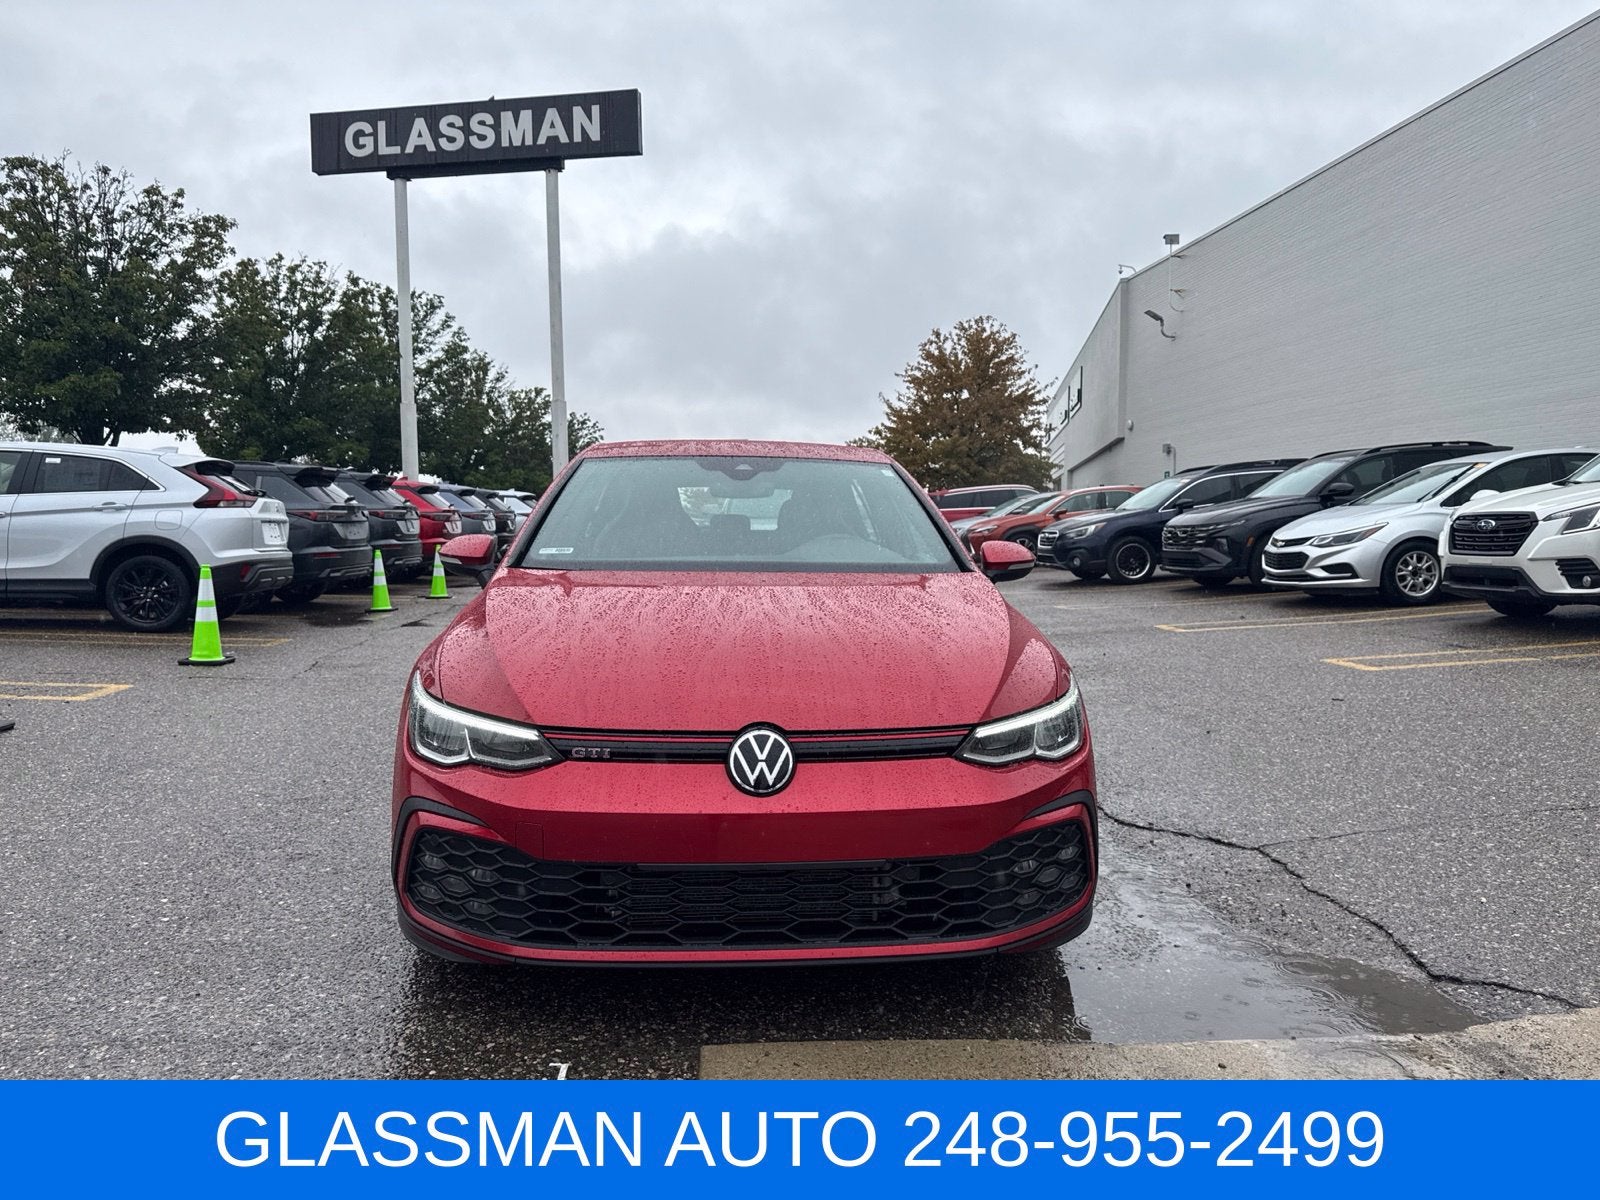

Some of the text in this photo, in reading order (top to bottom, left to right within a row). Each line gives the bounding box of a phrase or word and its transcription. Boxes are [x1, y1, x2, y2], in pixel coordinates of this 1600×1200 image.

[344, 104, 602, 158] GLASSMAN
[571, 746, 611, 759] GTI
[730, 728, 793, 792] VW
